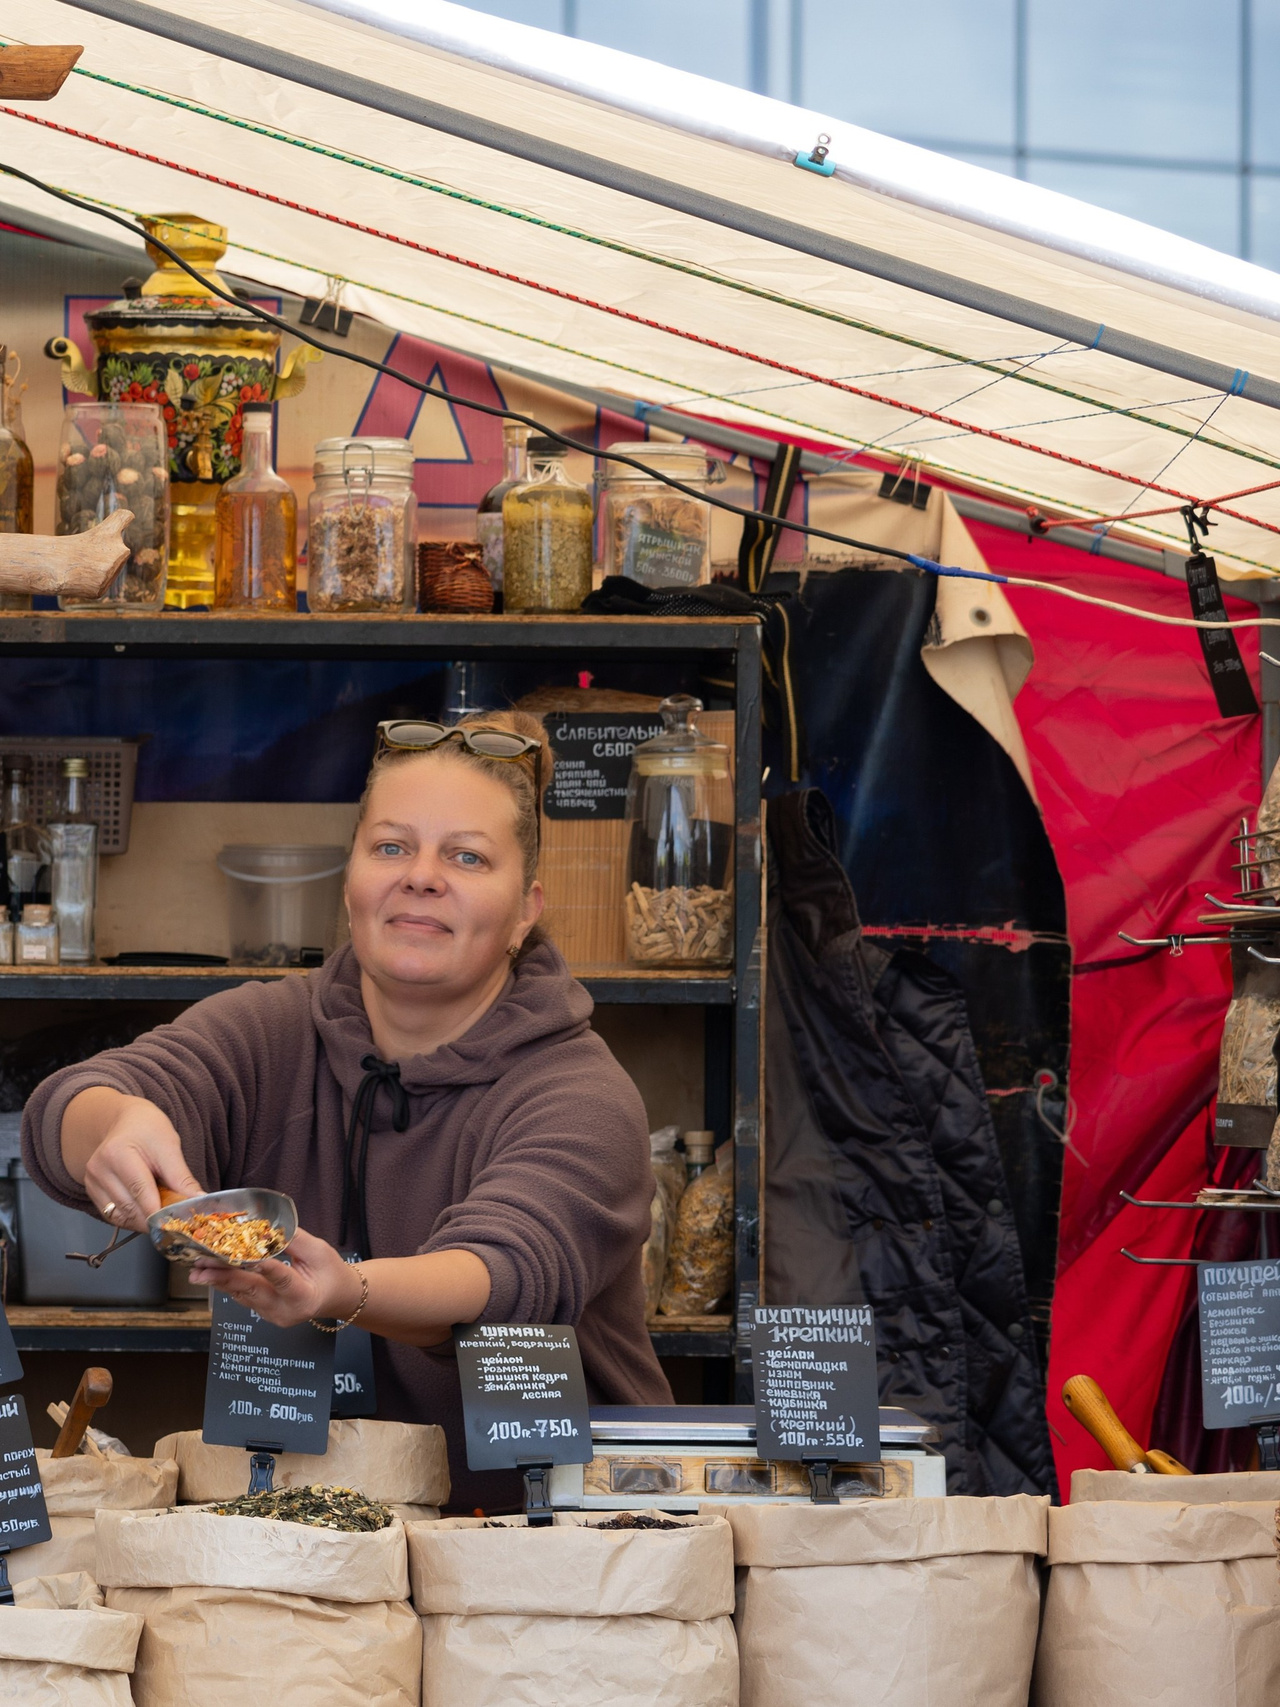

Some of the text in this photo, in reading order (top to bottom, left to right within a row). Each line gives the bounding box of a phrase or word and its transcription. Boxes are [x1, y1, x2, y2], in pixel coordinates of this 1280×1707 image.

[593, 742, 636, 757] СБОР
[1207, 1306, 1265, 1318] ЛЕМОНГРАСС
[223, 1322, 253, 1333] СЕНЧА
[1209, 1318, 1255, 1328] БРУСНИКА
[223, 1333, 247, 1342] ЛИПА
[511, 1337, 570, 1350] БОДРЯЩИЙ
[222, 1343, 269, 1355] РОМАШКА
[766, 1346, 815, 1361] ЦЕЙЛОН
[222, 1352, 315, 1370] ЦЕДРА МАНДАРИНА
[1212, 1356, 1252, 1366] КАРКАДЭ
[220, 1363, 281, 1376] ЛЕМОНГРАСС
[768, 1370, 802, 1379] ИЗЮМ
[219, 1372, 241, 1382] ЛИСТ
[533, 1373, 568, 1384] КЕДРА
[258, 1384, 317, 1398] СМОРОДИНЫ
[766, 1379, 836, 1391] ШИПОВНИК
[522, 1390, 561, 1400] ЛЕСНАЯ
[766, 1388, 821, 1400] ЕЖЕВИКА
[769, 1398, 827, 1411] КЛУБНИКА
[771, 1409, 818, 1420] МАЛИНА
[4, 1448, 35, 1463] ПОРОХ
